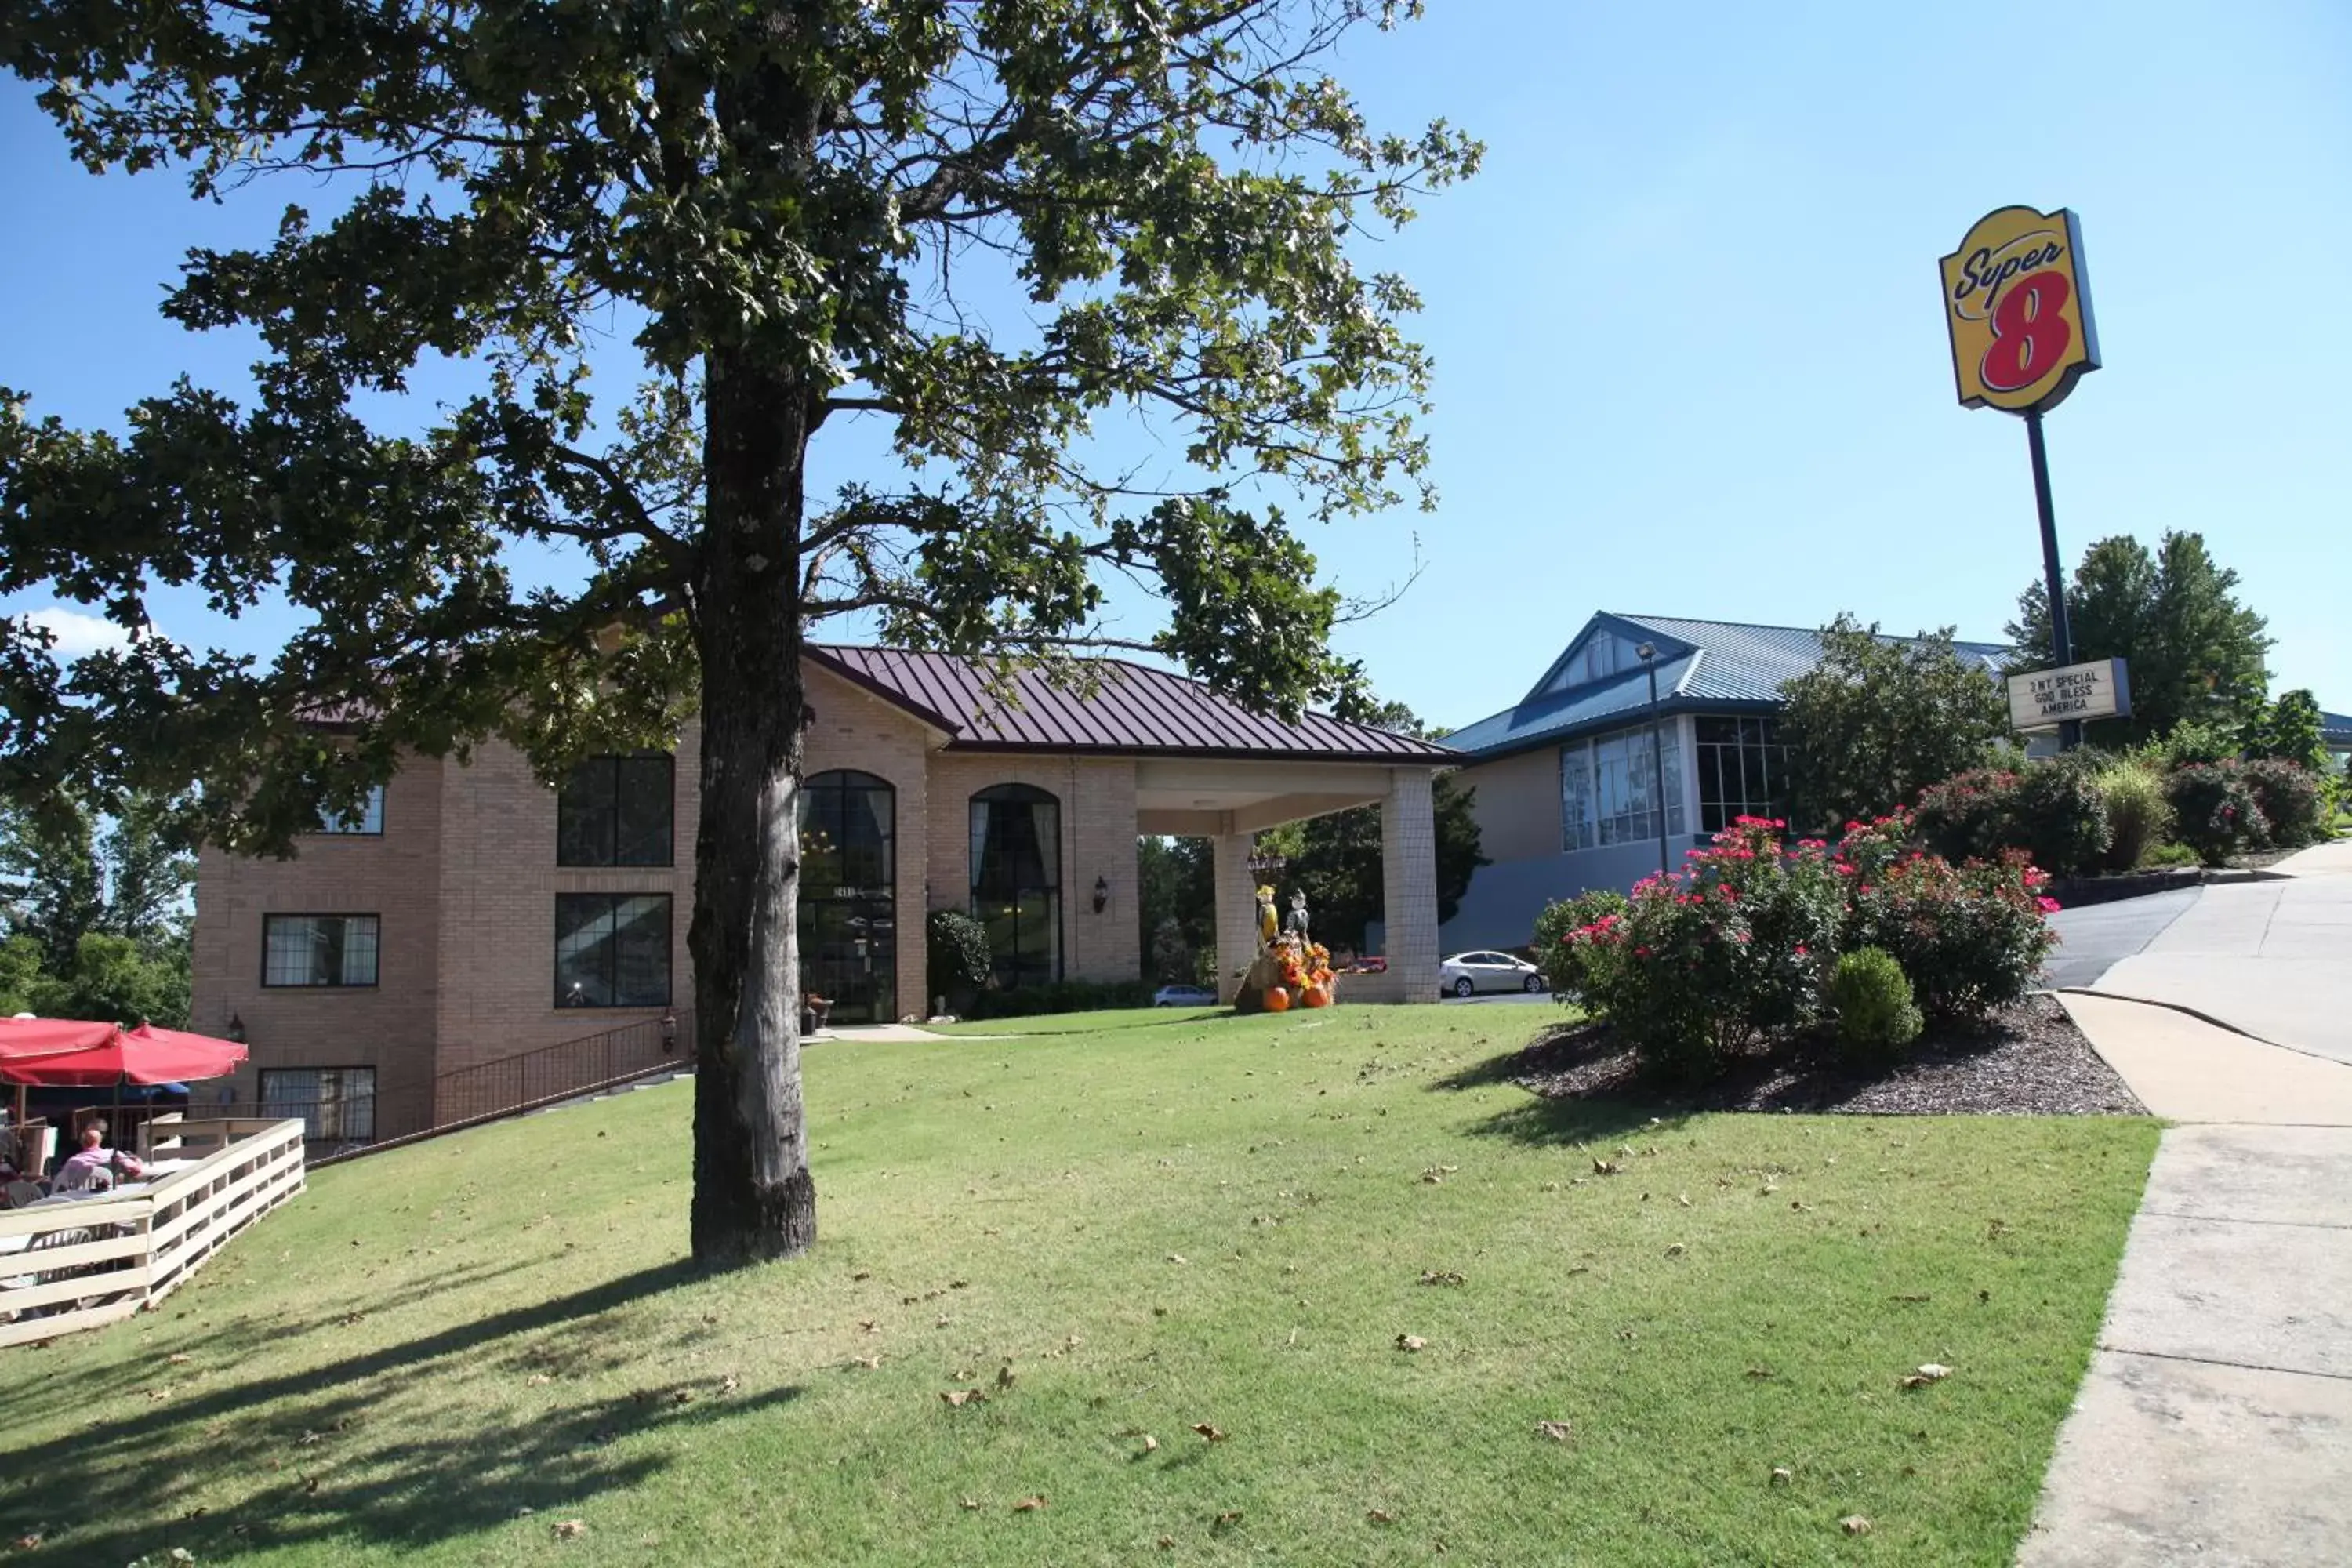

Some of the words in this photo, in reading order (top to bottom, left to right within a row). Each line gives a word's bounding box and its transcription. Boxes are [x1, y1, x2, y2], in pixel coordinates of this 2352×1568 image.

[1955, 241, 2065, 310] Super
[1980, 270, 2071, 392] 8
[2056, 671, 2098, 688] SPECIAL
[2034, 691, 2055, 703] GOD
[2042, 699, 2087, 715] AMERICA
